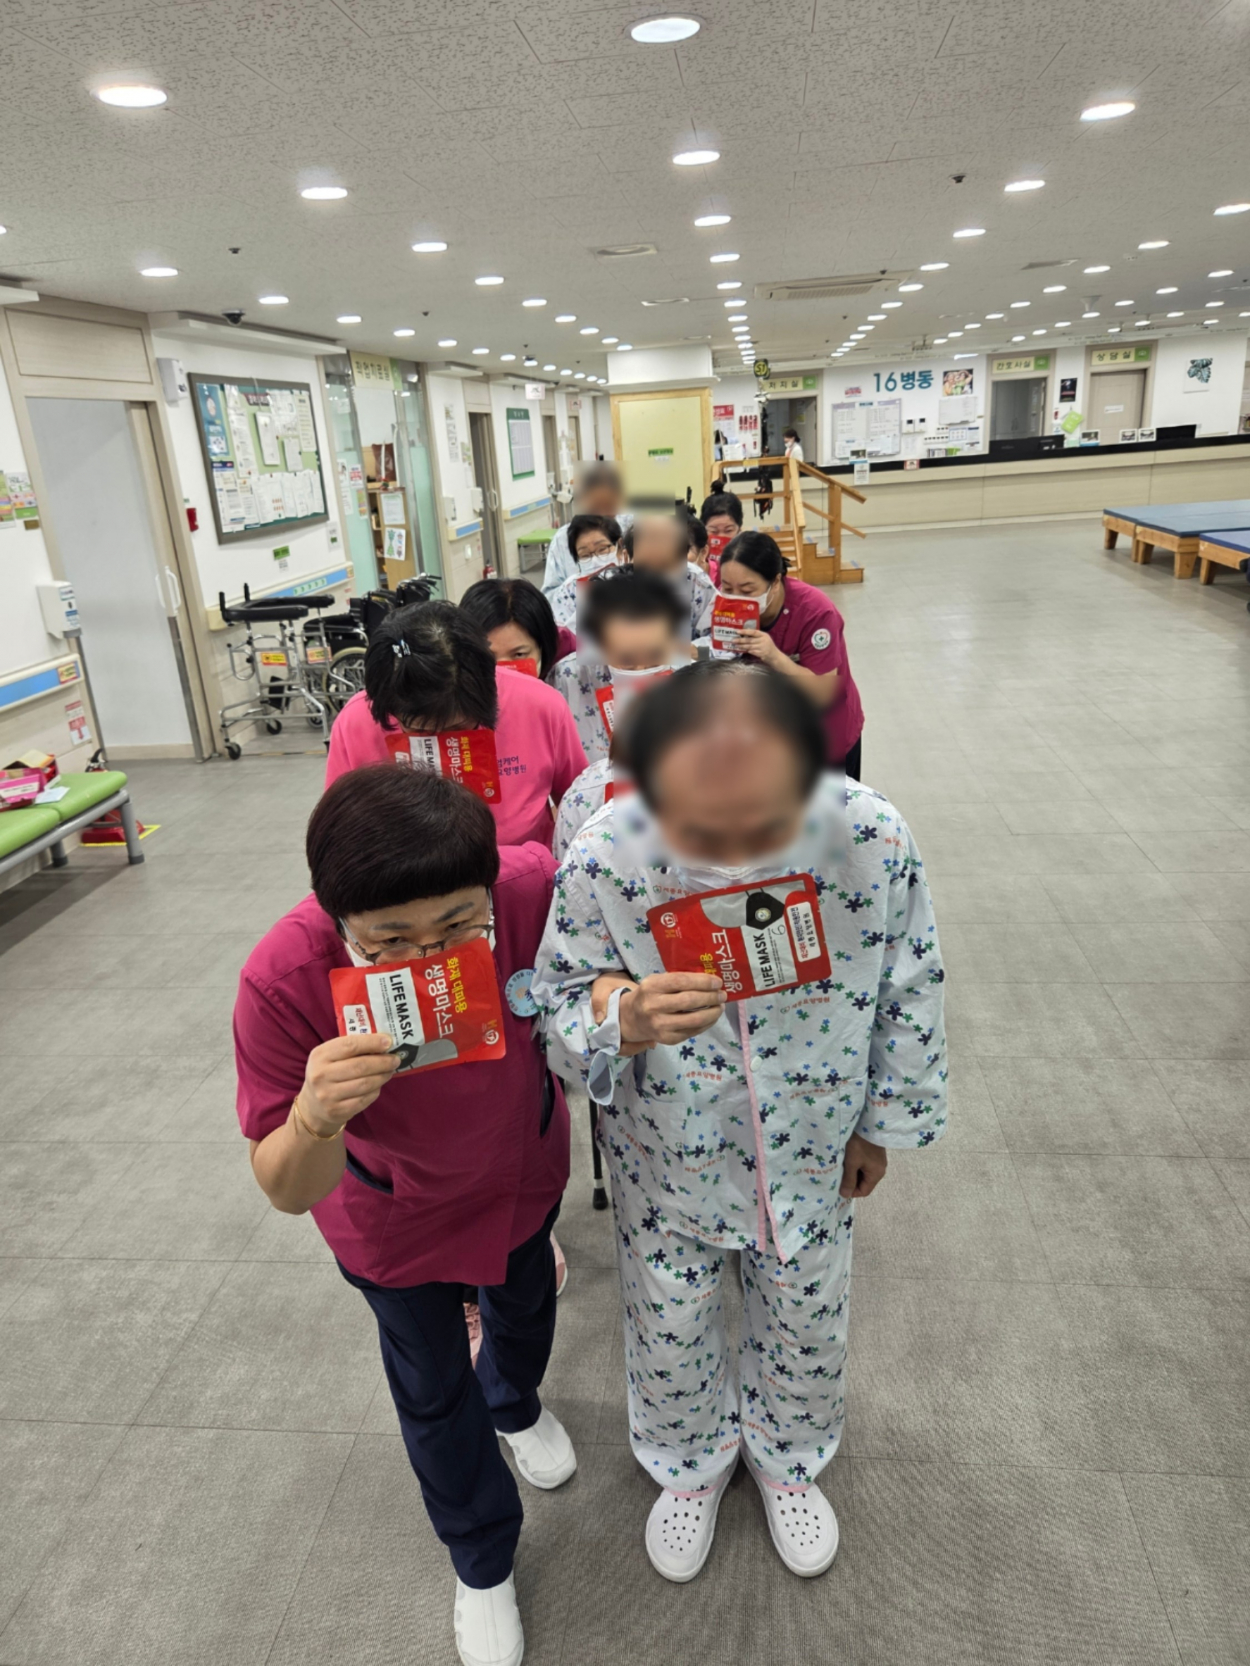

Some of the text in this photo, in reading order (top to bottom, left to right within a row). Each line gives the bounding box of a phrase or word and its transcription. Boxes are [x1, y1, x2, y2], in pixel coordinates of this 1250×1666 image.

[996, 360, 1032, 371] 간호사실
[1096, 350, 1132, 362] 상담실
[423, 738, 435, 756] LIFE
[446, 956, 468, 1013] 화재 대피용
[711, 929, 743, 993] 생명마스크
[752, 932, 776, 988] LIFE MASK
[388, 974, 415, 1041] LIFE MASK
[424, 964, 454, 1038] 생명마스크
